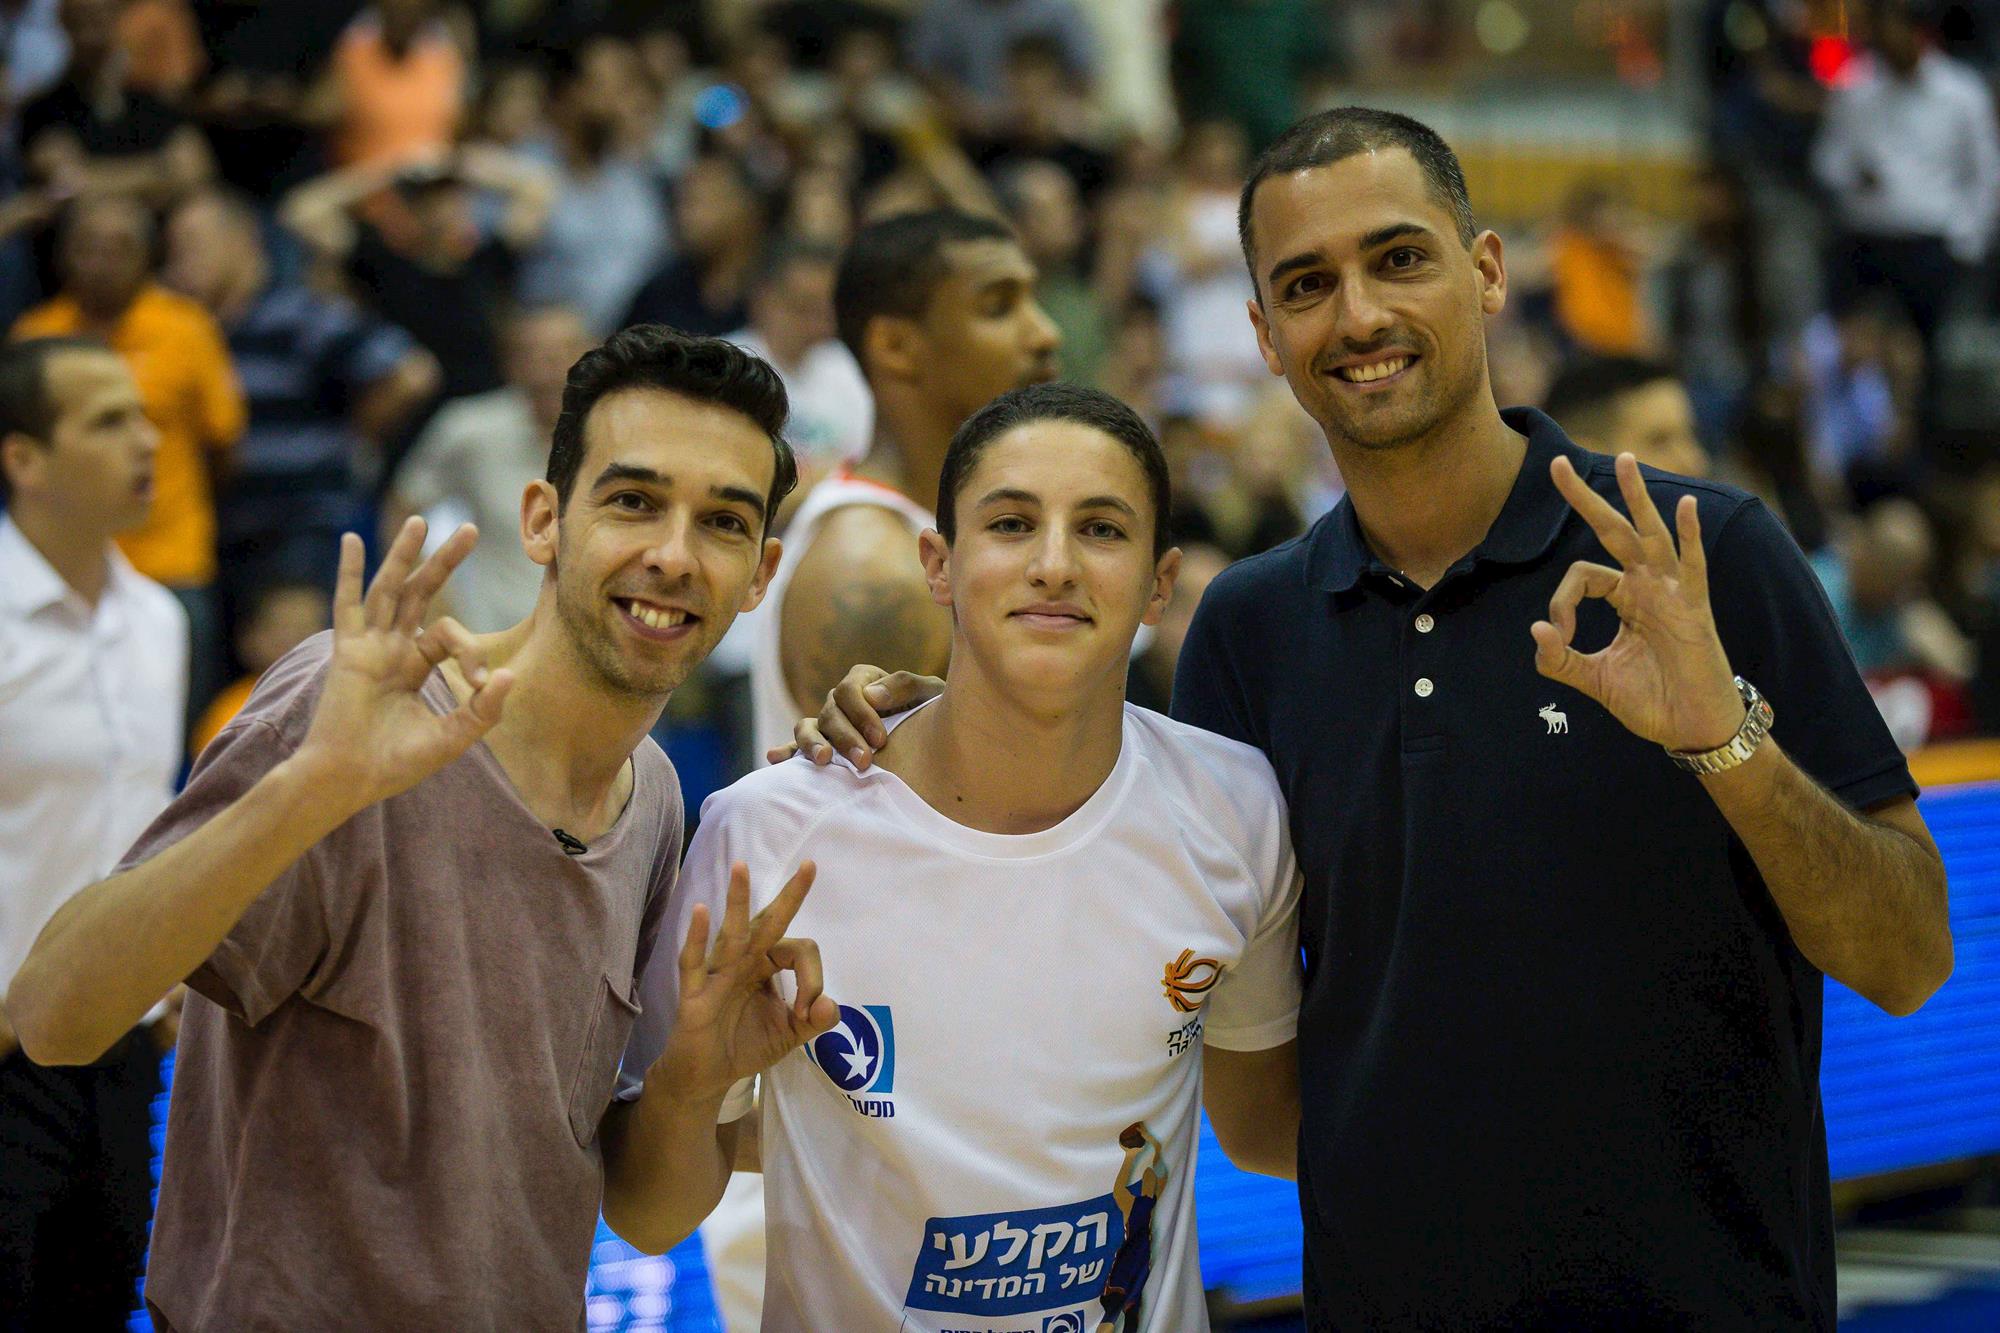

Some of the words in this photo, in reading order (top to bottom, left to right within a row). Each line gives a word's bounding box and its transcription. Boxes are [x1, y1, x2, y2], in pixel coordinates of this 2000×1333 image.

[933, 1211, 1109, 1270] הקלעי
[924, 1273, 1046, 1300] המדינה
[1059, 1258, 1105, 1289] של
